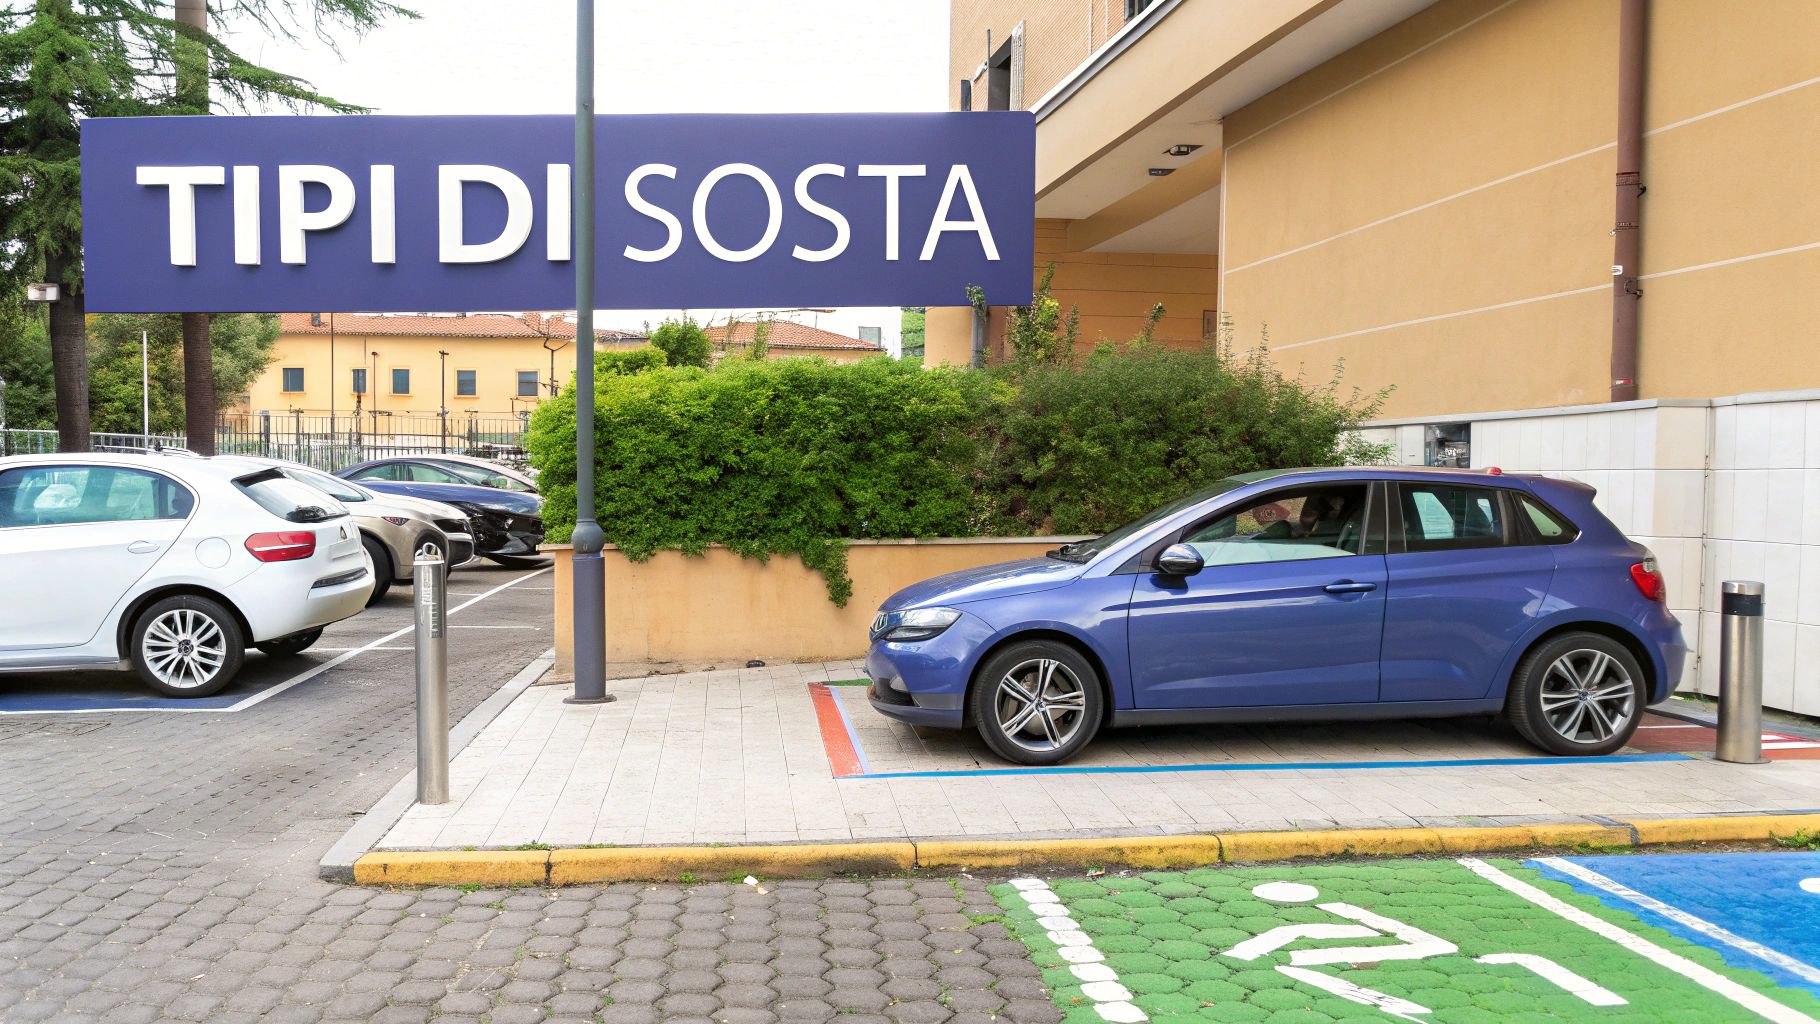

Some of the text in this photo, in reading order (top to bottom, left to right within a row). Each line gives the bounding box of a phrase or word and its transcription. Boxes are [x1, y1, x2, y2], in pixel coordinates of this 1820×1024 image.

[135, 162, 1001, 266] TIPI DI SOSTA
